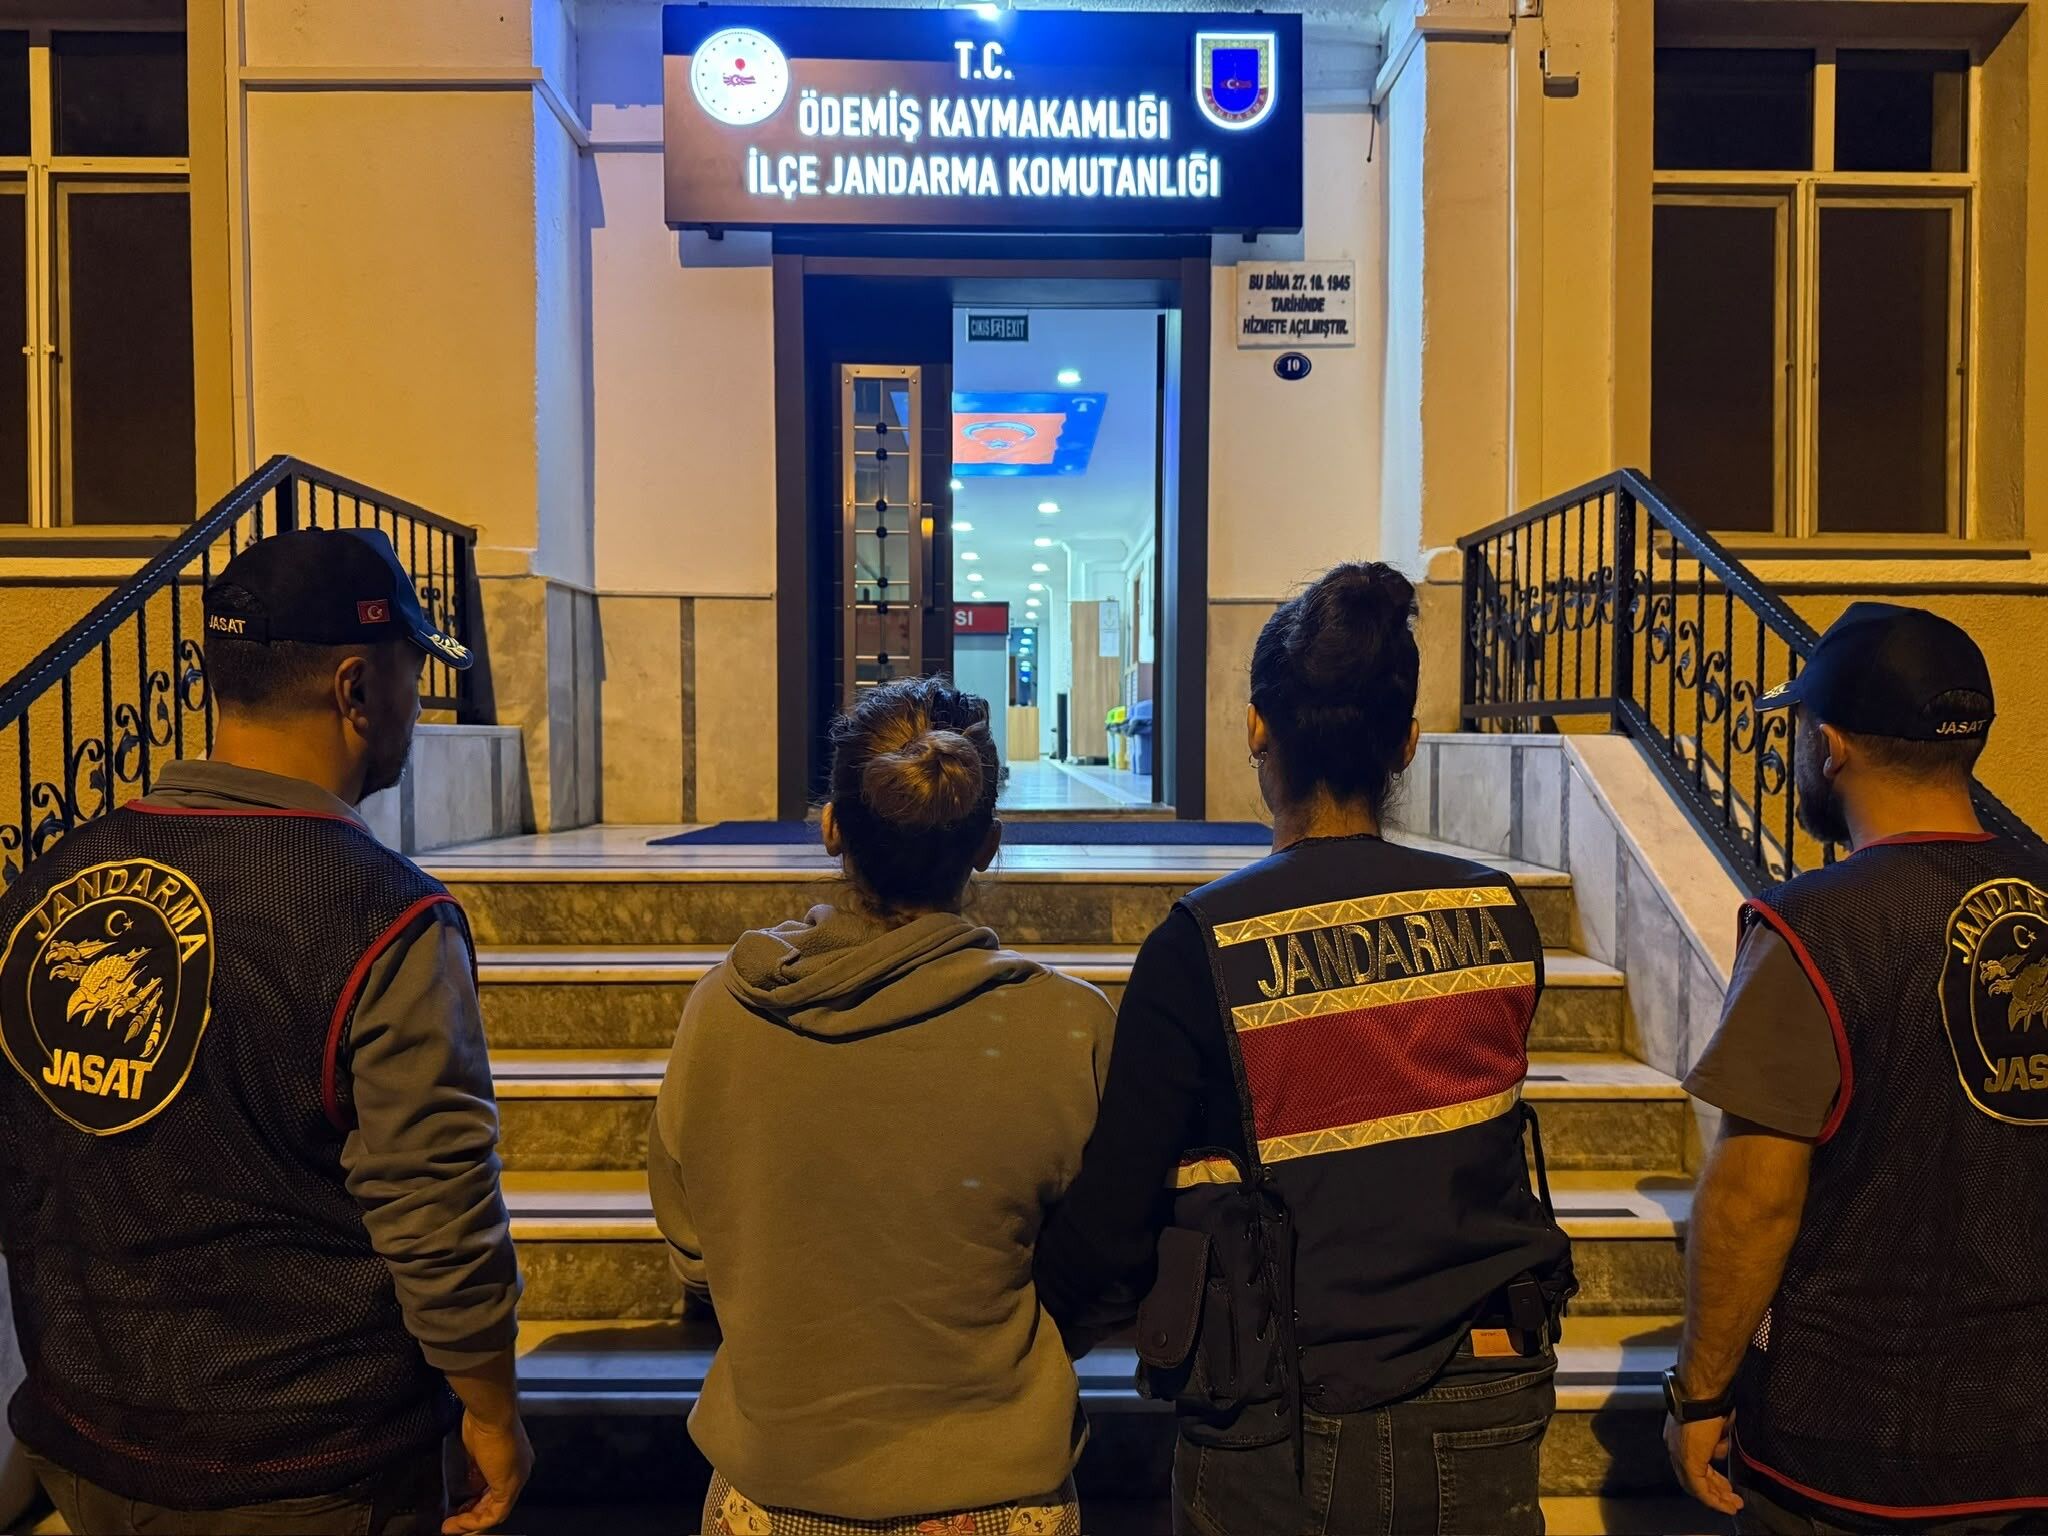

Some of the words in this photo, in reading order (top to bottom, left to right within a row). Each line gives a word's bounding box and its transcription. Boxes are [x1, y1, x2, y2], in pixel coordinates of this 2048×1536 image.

[954, 41, 1013, 79] T.C.
[799, 89, 920, 142] ÖDEMİŞ
[929, 93, 1169, 139] KAYMAKAMLIĞI
[748, 147, 819, 199] İLÇE
[825, 154, 1000, 194] JANDARMA
[1008, 152, 1221, 197] KOMUTANLIĞI
[1249, 274, 1263, 290] BU
[1265, 270, 1289, 290] BİNA
[1327, 275, 1350, 291] 1945
[1271, 294, 1325, 312] TARİHİNDE
[1006, 319, 1025, 337] EXIT
[1243, 315, 1287, 334] HİZMETE
[1287, 358, 1300, 371] 10
[208, 614, 246, 634] JASAT
[1935, 719, 1987, 735] JASAT
[34, 867, 208, 963] JANDARMA
[1257, 907, 1514, 998] JANDARMA
[42, 1049, 153, 1100] JASAT
